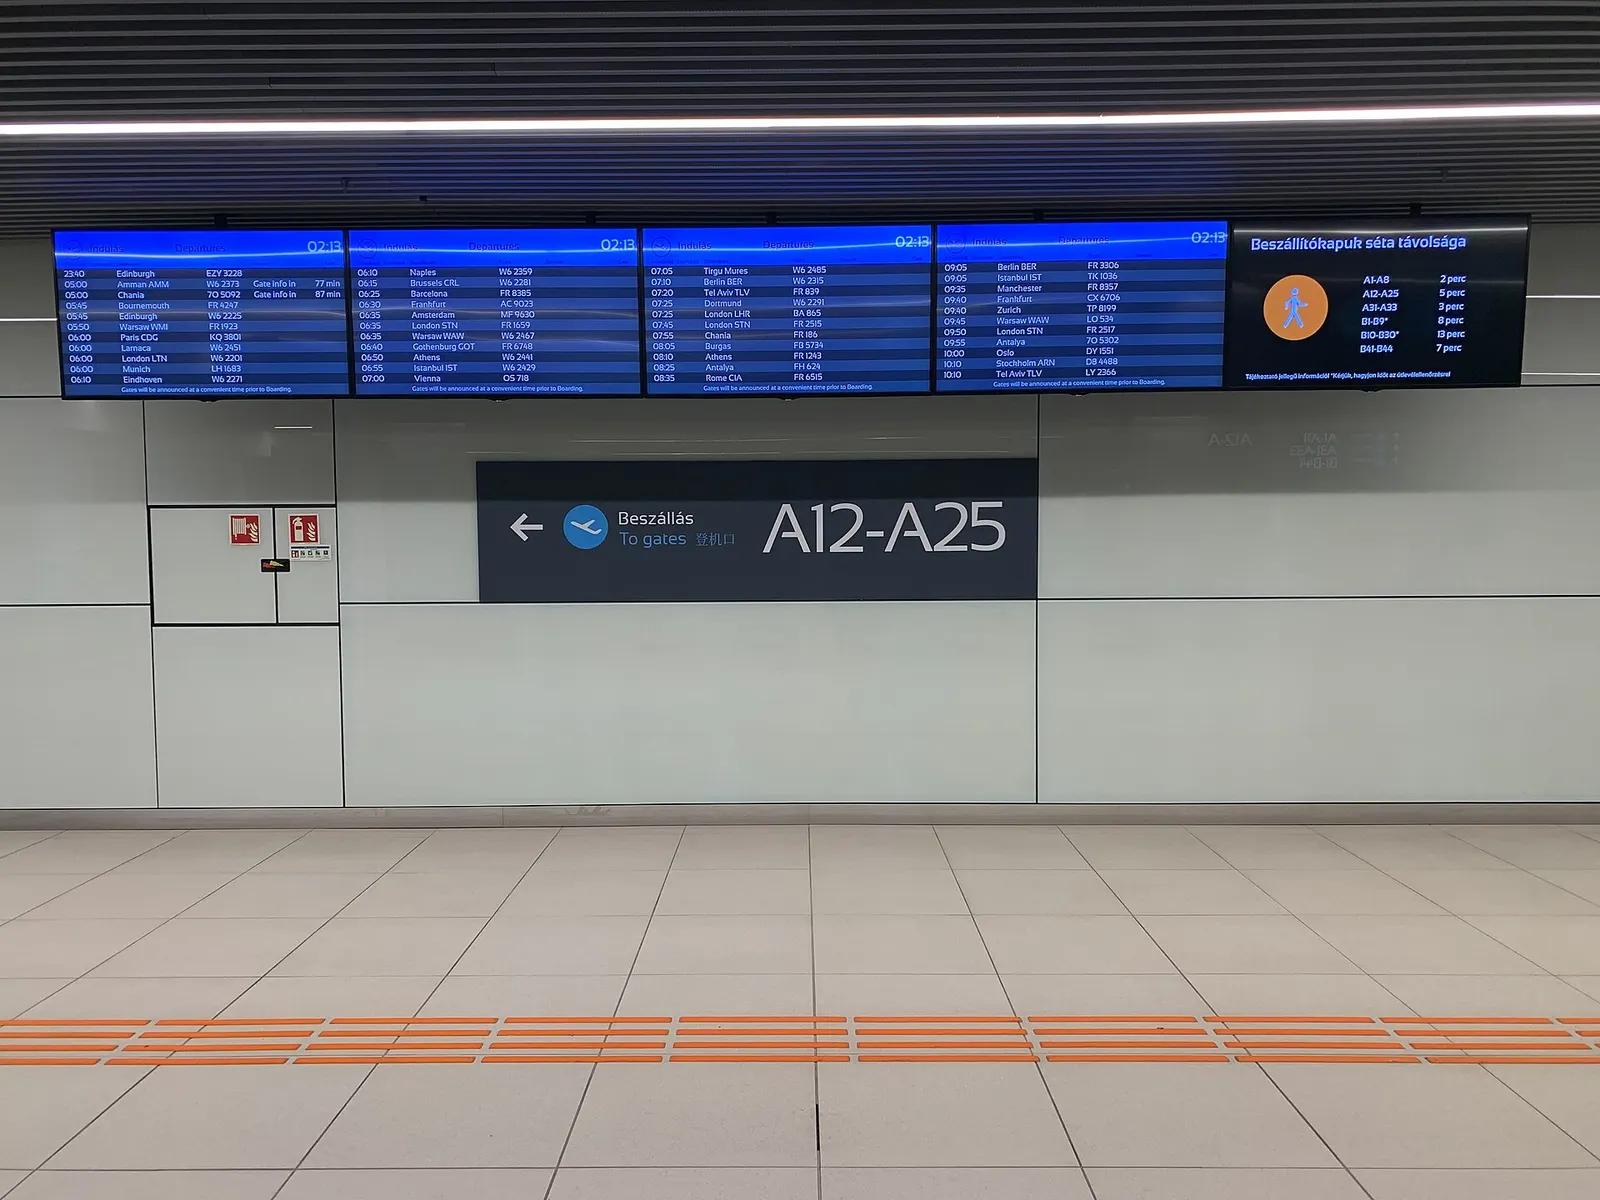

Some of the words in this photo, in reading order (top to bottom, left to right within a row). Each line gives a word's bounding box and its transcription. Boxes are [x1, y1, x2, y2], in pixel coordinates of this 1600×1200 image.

[763, 240, 813, 249] Departures
[895, 236, 929, 247] 02:13
[1058, 236, 1109, 246] Departures
[1191, 232, 1225, 243] 02:13
[1251, 236, 1362, 252] Beszállítókapuk
[1365, 238, 1394, 249] séta
[1398, 235, 1466, 250] távolsága
[176, 244, 226, 253] Departures
[308, 241, 341, 252] 02:13
[469, 242, 519, 251] Departures
[601, 239, 634, 250] 02:13
[116, 270, 155, 278] Edinburgh
[703, 267, 722, 276] Tirgu
[1363, 276, 1390, 284] A1-A8
[1448, 276, 1466, 284] perc
[1362, 289, 1399, 298] A12-A25
[1447, 290, 1465, 298] perc
[1446, 304, 1464, 312] perc
[1445, 318, 1464, 326] perc
[209, 333, 222, 341] KQ
[1447, 331, 1465, 339] perc
[1360, 345, 1393, 353] B41-B44
[1443, 345, 1462, 353] perc
[618, 512, 694, 525] Beszállás
[762, 501, 1006, 553] A12-A25
[620, 532, 638, 545] To
[643, 532, 686, 548] gates
[695, 532, 735, 547] 登机口
